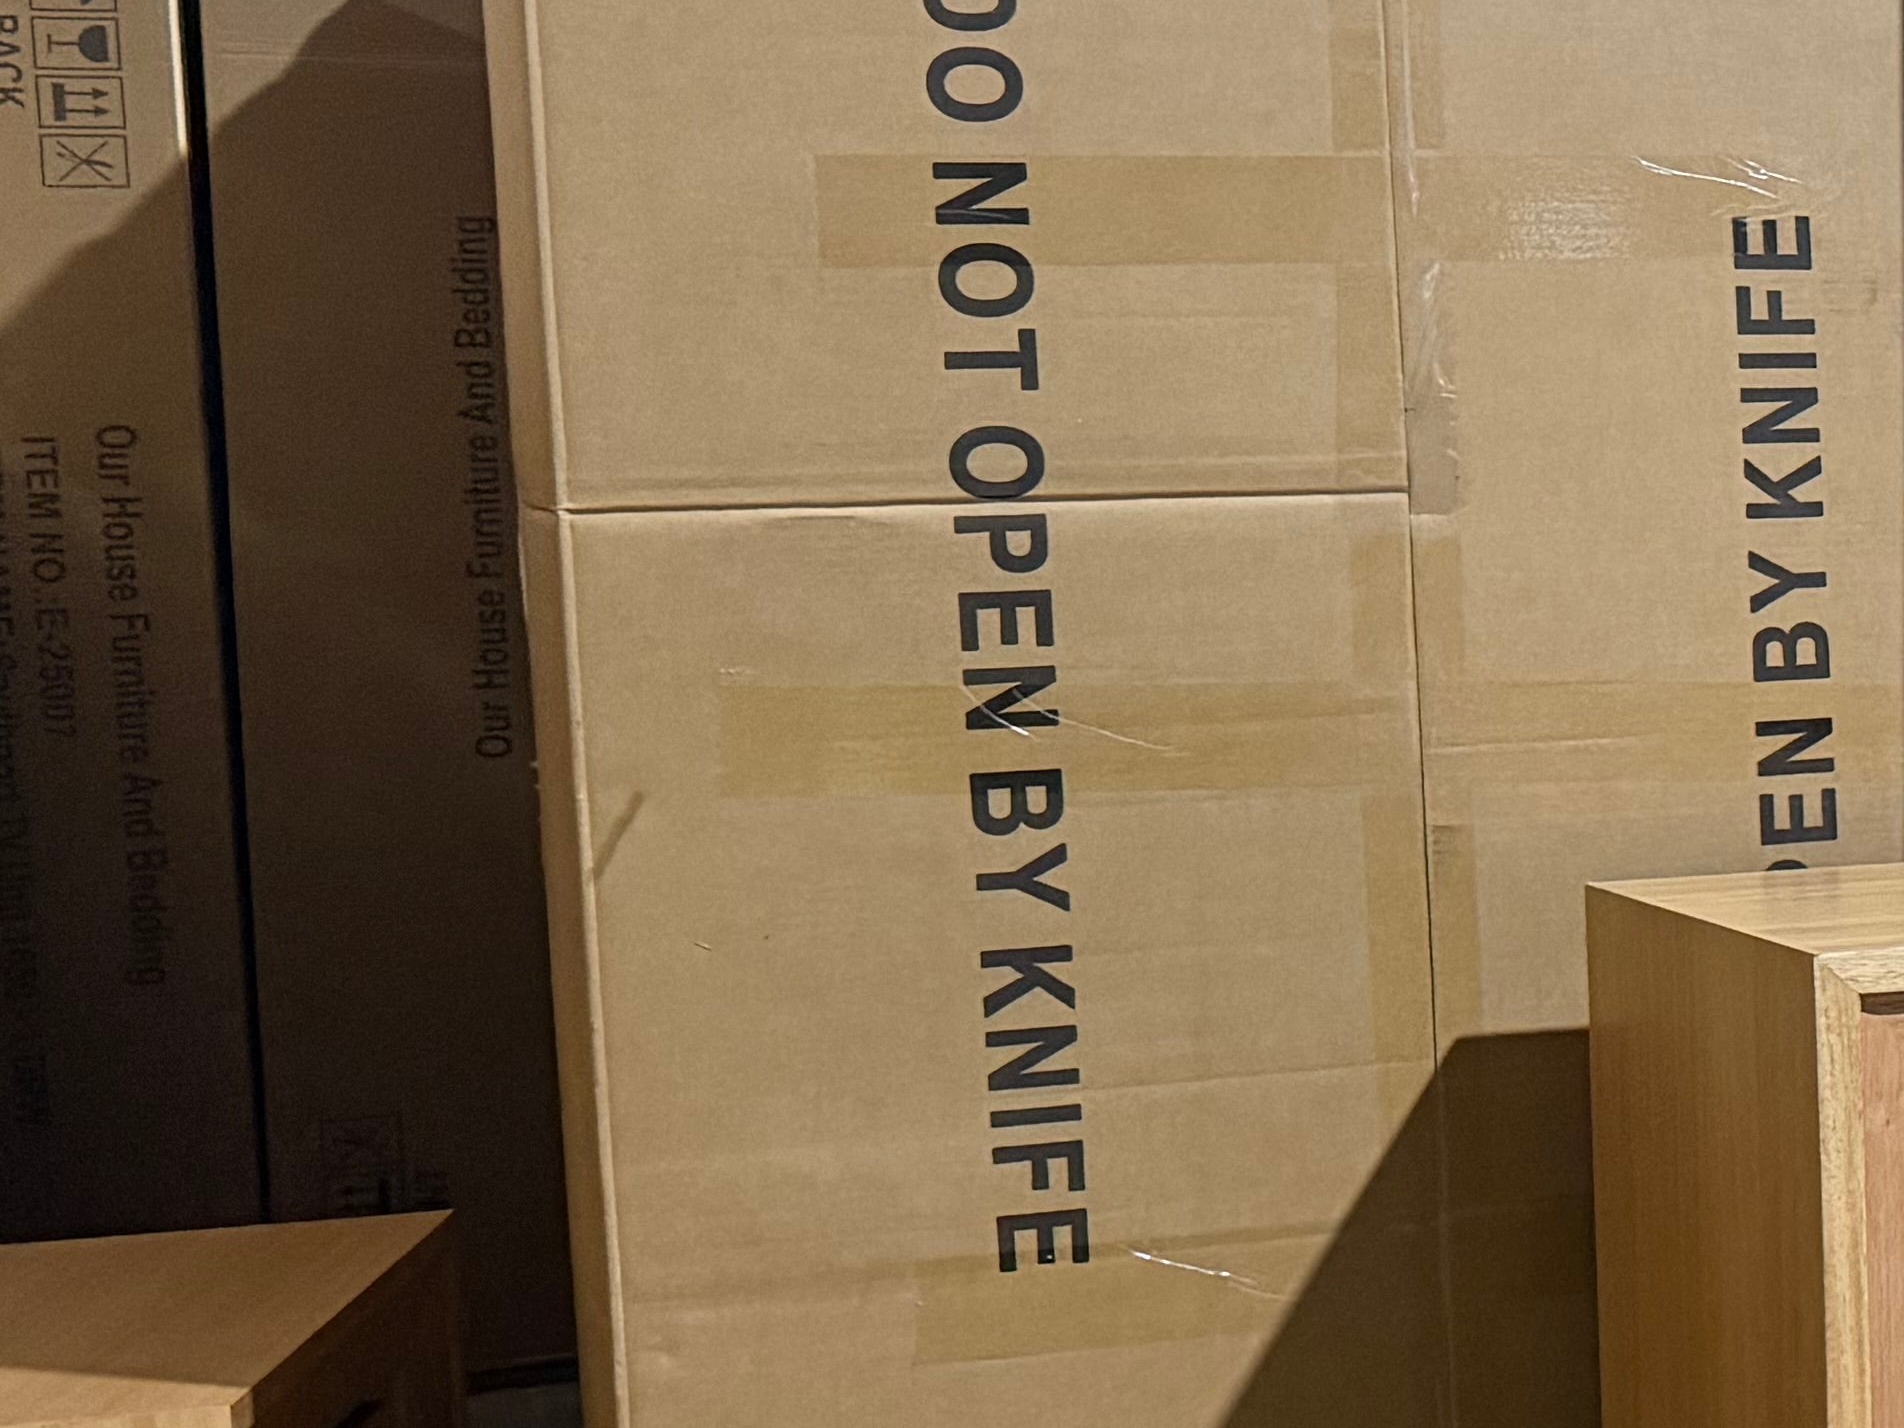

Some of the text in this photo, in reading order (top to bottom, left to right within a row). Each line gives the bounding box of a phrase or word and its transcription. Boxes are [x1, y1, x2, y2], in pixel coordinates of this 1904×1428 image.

[931, 160, 1040, 393] NOT
[1732, 214, 1823, 521] KNIFE
[20, 436, 62, 519] ITEM
[94, 424, 139, 486] Our
[451, 214, 514, 759] Our House Furniture And Bedding
[100, 495, 144, 603] House
[947, 424, 1061, 736] OPEN
[1747, 549, 1831, 684] BY
[107, 613, 157, 763] Furniture
[121, 772, 164, 839] And
[969, 767, 1071, 914] BY
[979, 943, 1089, 1275] KNIFE
